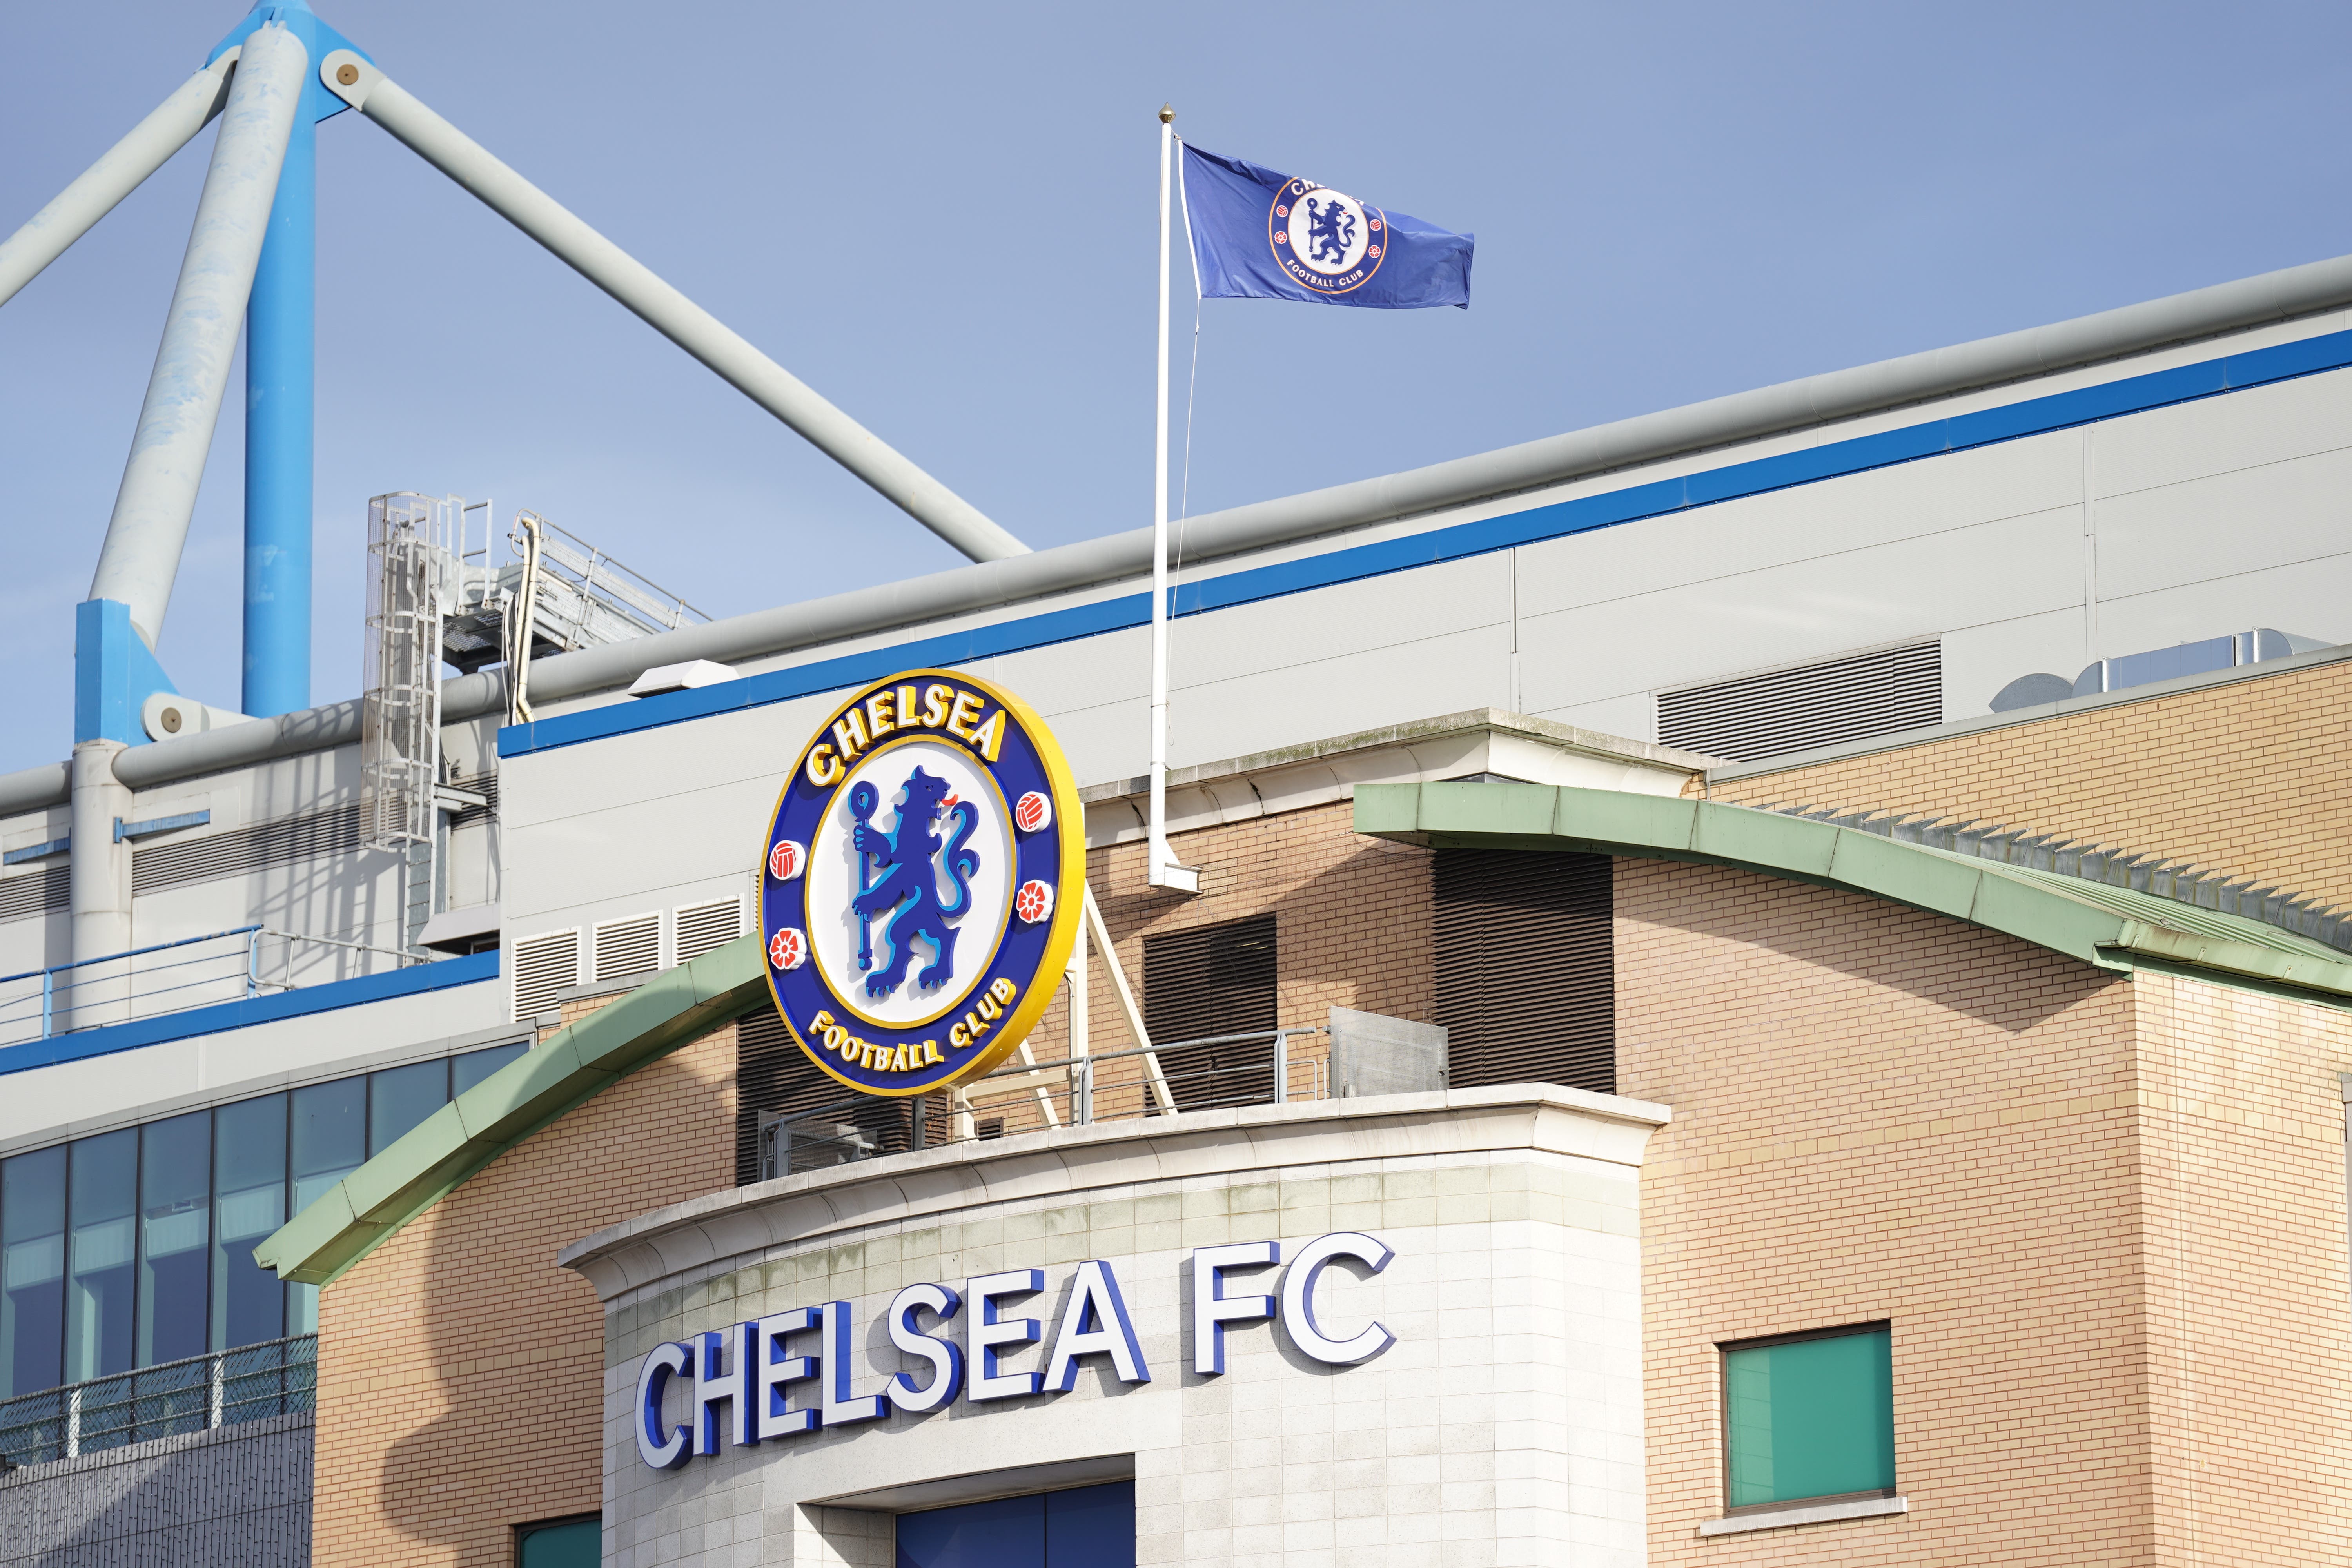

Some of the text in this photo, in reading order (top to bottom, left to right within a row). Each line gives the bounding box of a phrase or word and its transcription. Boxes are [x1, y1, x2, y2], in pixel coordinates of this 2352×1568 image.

[1287, 259, 1364, 287] FOOTBALL CLUB
[806, 684, 1007, 787] CHELSEA
[808, 977, 1017, 1071] FOOTBALL CLUB
[634, 1231, 1397, 1471] CHELSEA FC
